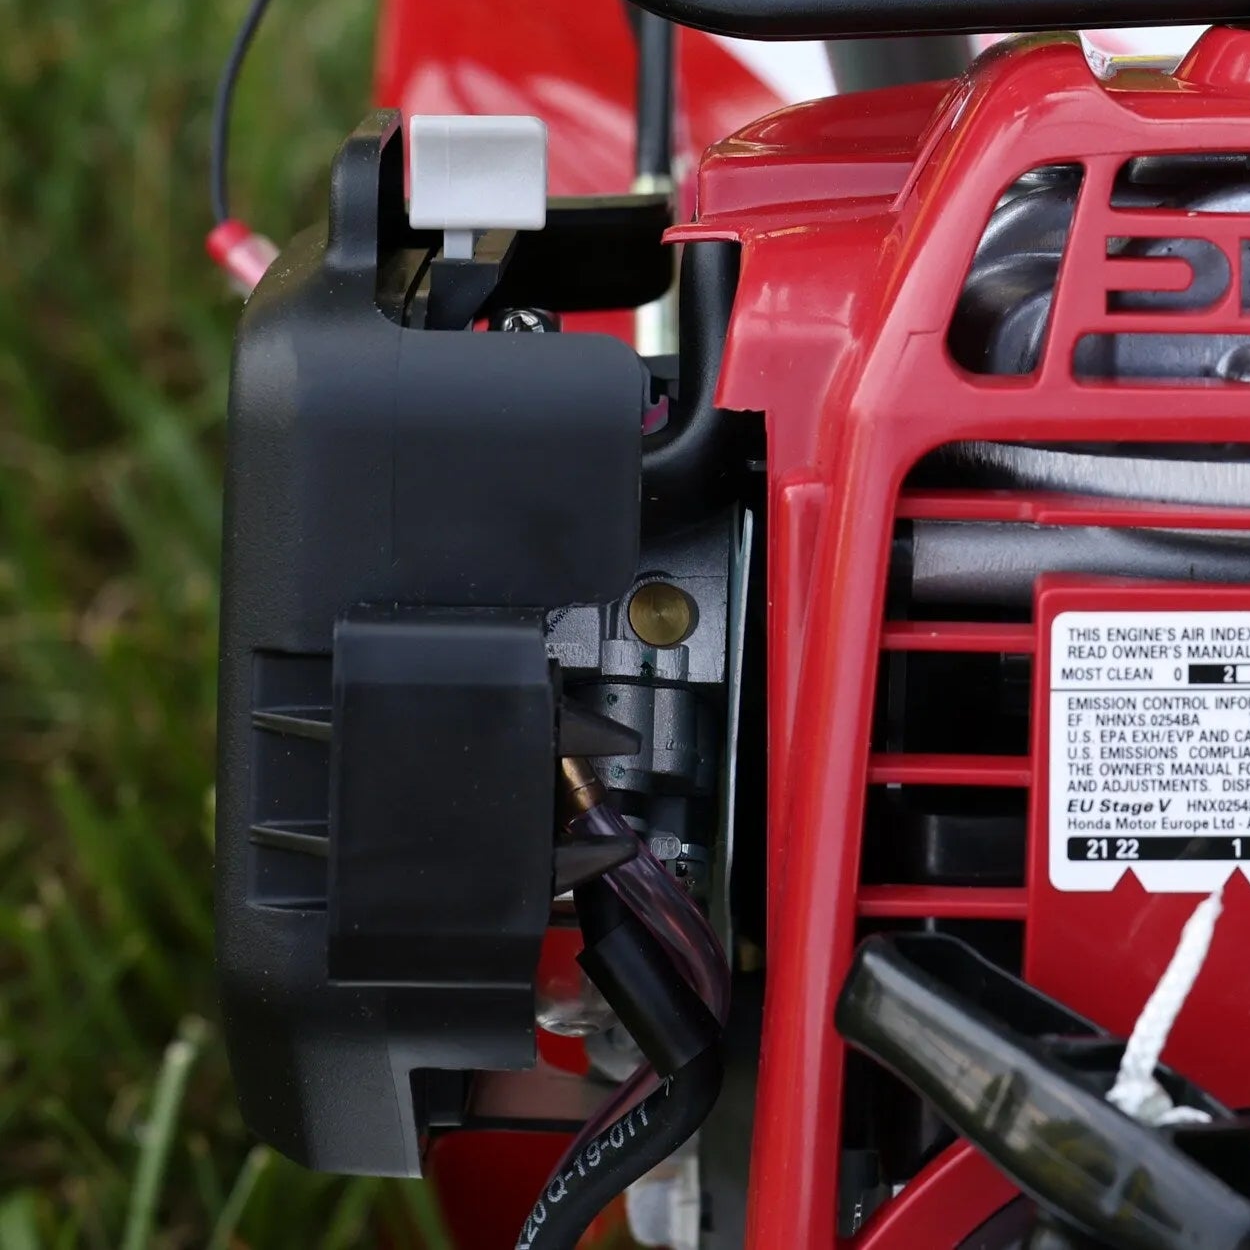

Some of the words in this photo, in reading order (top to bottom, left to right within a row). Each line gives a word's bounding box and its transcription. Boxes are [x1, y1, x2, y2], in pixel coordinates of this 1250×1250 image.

[1069, 628, 1100, 641] THIS
[1107, 628, 1176, 641] ENGINE'S
[1181, 627, 1204, 641] AIR
[1068, 645, 1106, 659] READ
[1112, 645, 1182, 659] OWNER'S
[1061, 667, 1102, 680] MOST
[1107, 667, 1153, 680] CLEAN
[1174, 667, 1182, 680] 0
[1224, 666, 1234, 682] 2
[1068, 697, 1136, 710] EMISSION
[1142, 697, 1208, 710] CONTROL
[1068, 715, 1083, 727] EF
[1101, 731, 1127, 743] EPA
[1132, 730, 1194, 743] EXH/EVP
[1199, 730, 1229, 742] AND
[1100, 747, 1178, 759] EMISSIONS
[1068, 763, 1093, 776] THE
[1100, 763, 1165, 777] OWNER'S
[1171, 763, 1231, 776] MANUAL
[1067, 780, 1097, 792] AND
[1102, 779, 1211, 792] ADJUSTMENTS.
[1067, 799, 1093, 813] EU
[1100, 799, 1154, 815] Stage
[1159, 799, 1171, 812] V
[1068, 817, 1111, 830] Honda
[1115, 817, 1156, 830] Motor
[1161, 817, 1208, 832] Europe
[1213, 817, 1235, 829] Ltd
[1086, 839, 1108, 859] 21
[1115, 839, 1140, 859] 22
[1231, 838, 1242, 858] 1
